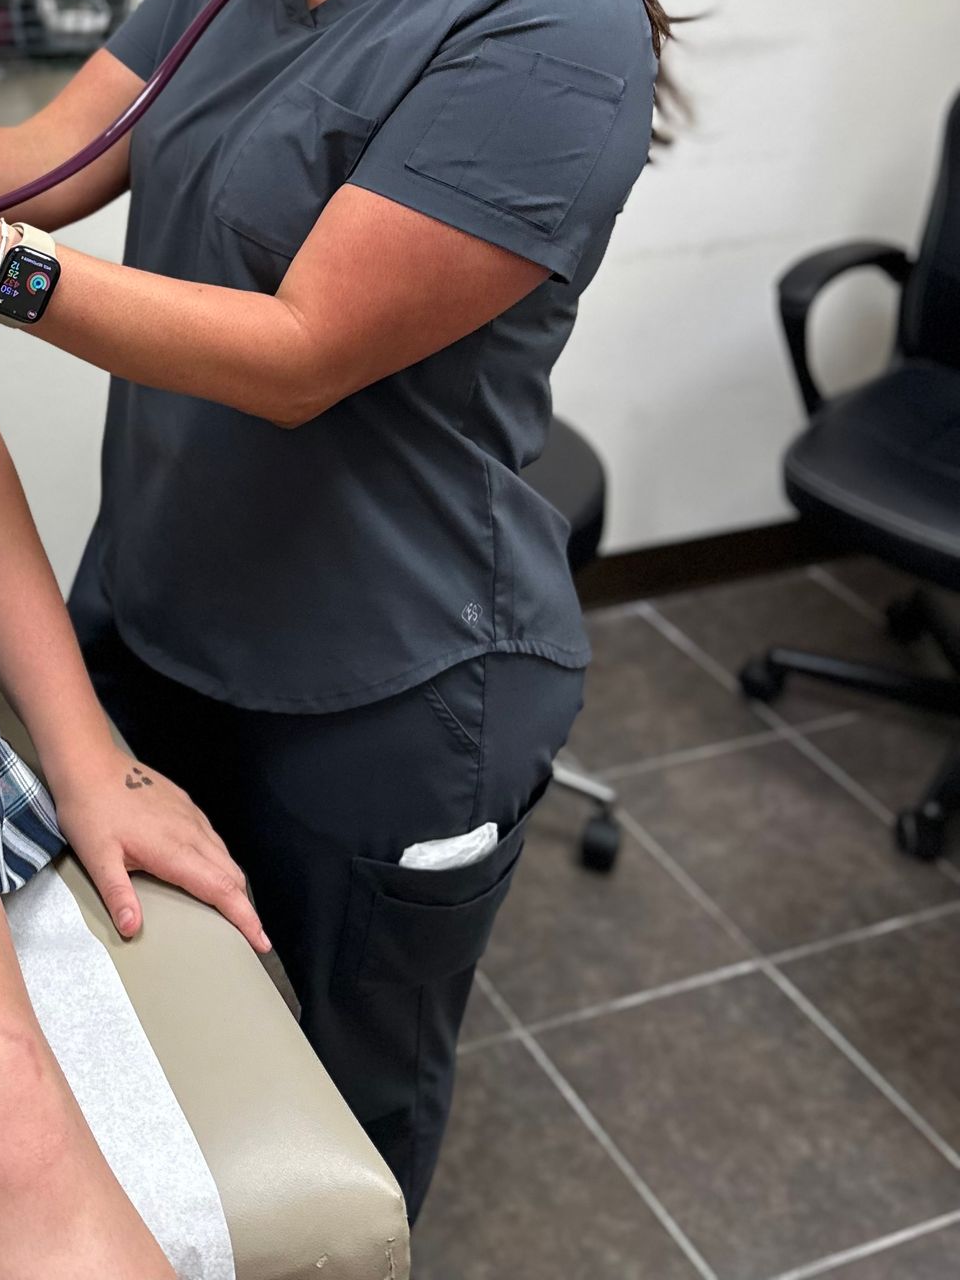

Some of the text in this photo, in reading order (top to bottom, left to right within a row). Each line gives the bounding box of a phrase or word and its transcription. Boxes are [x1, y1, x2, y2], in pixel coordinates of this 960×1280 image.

[10, 261, 20, 270] 12
[7, 269, 20, 279] 25
[0, 285, 19, 297] 4:50
